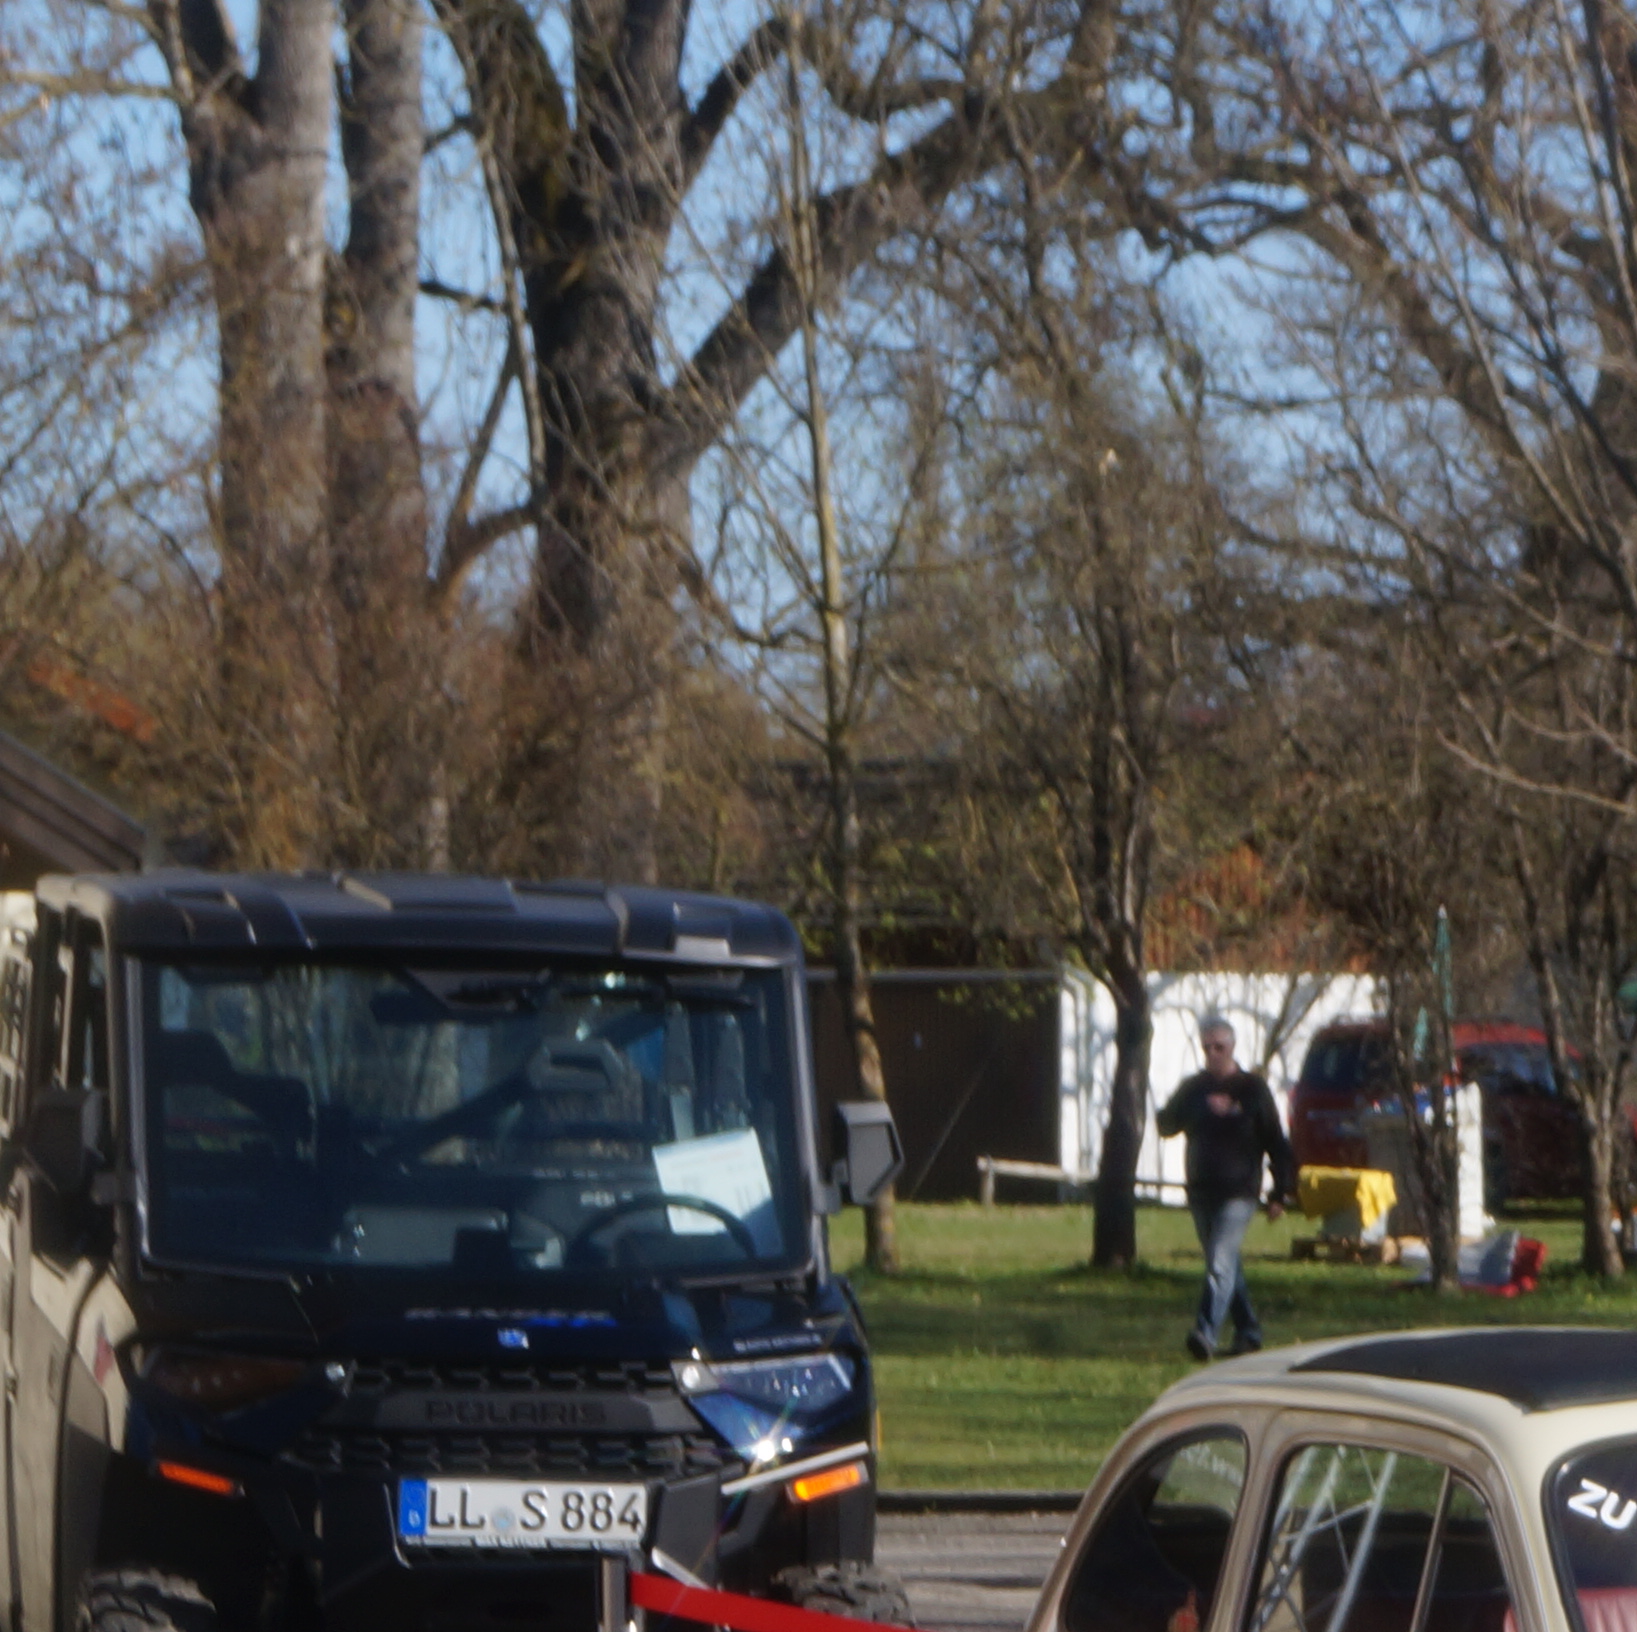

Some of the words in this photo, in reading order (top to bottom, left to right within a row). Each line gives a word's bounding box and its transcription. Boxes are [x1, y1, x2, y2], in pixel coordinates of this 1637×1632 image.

[425, 1401, 607, 1424] POLARIS
[431, 1486, 486, 1530] LL
[519, 1489, 548, 1531] S
[561, 1491, 643, 1533] 884
[1567, 1478, 1637, 1530] ZU
